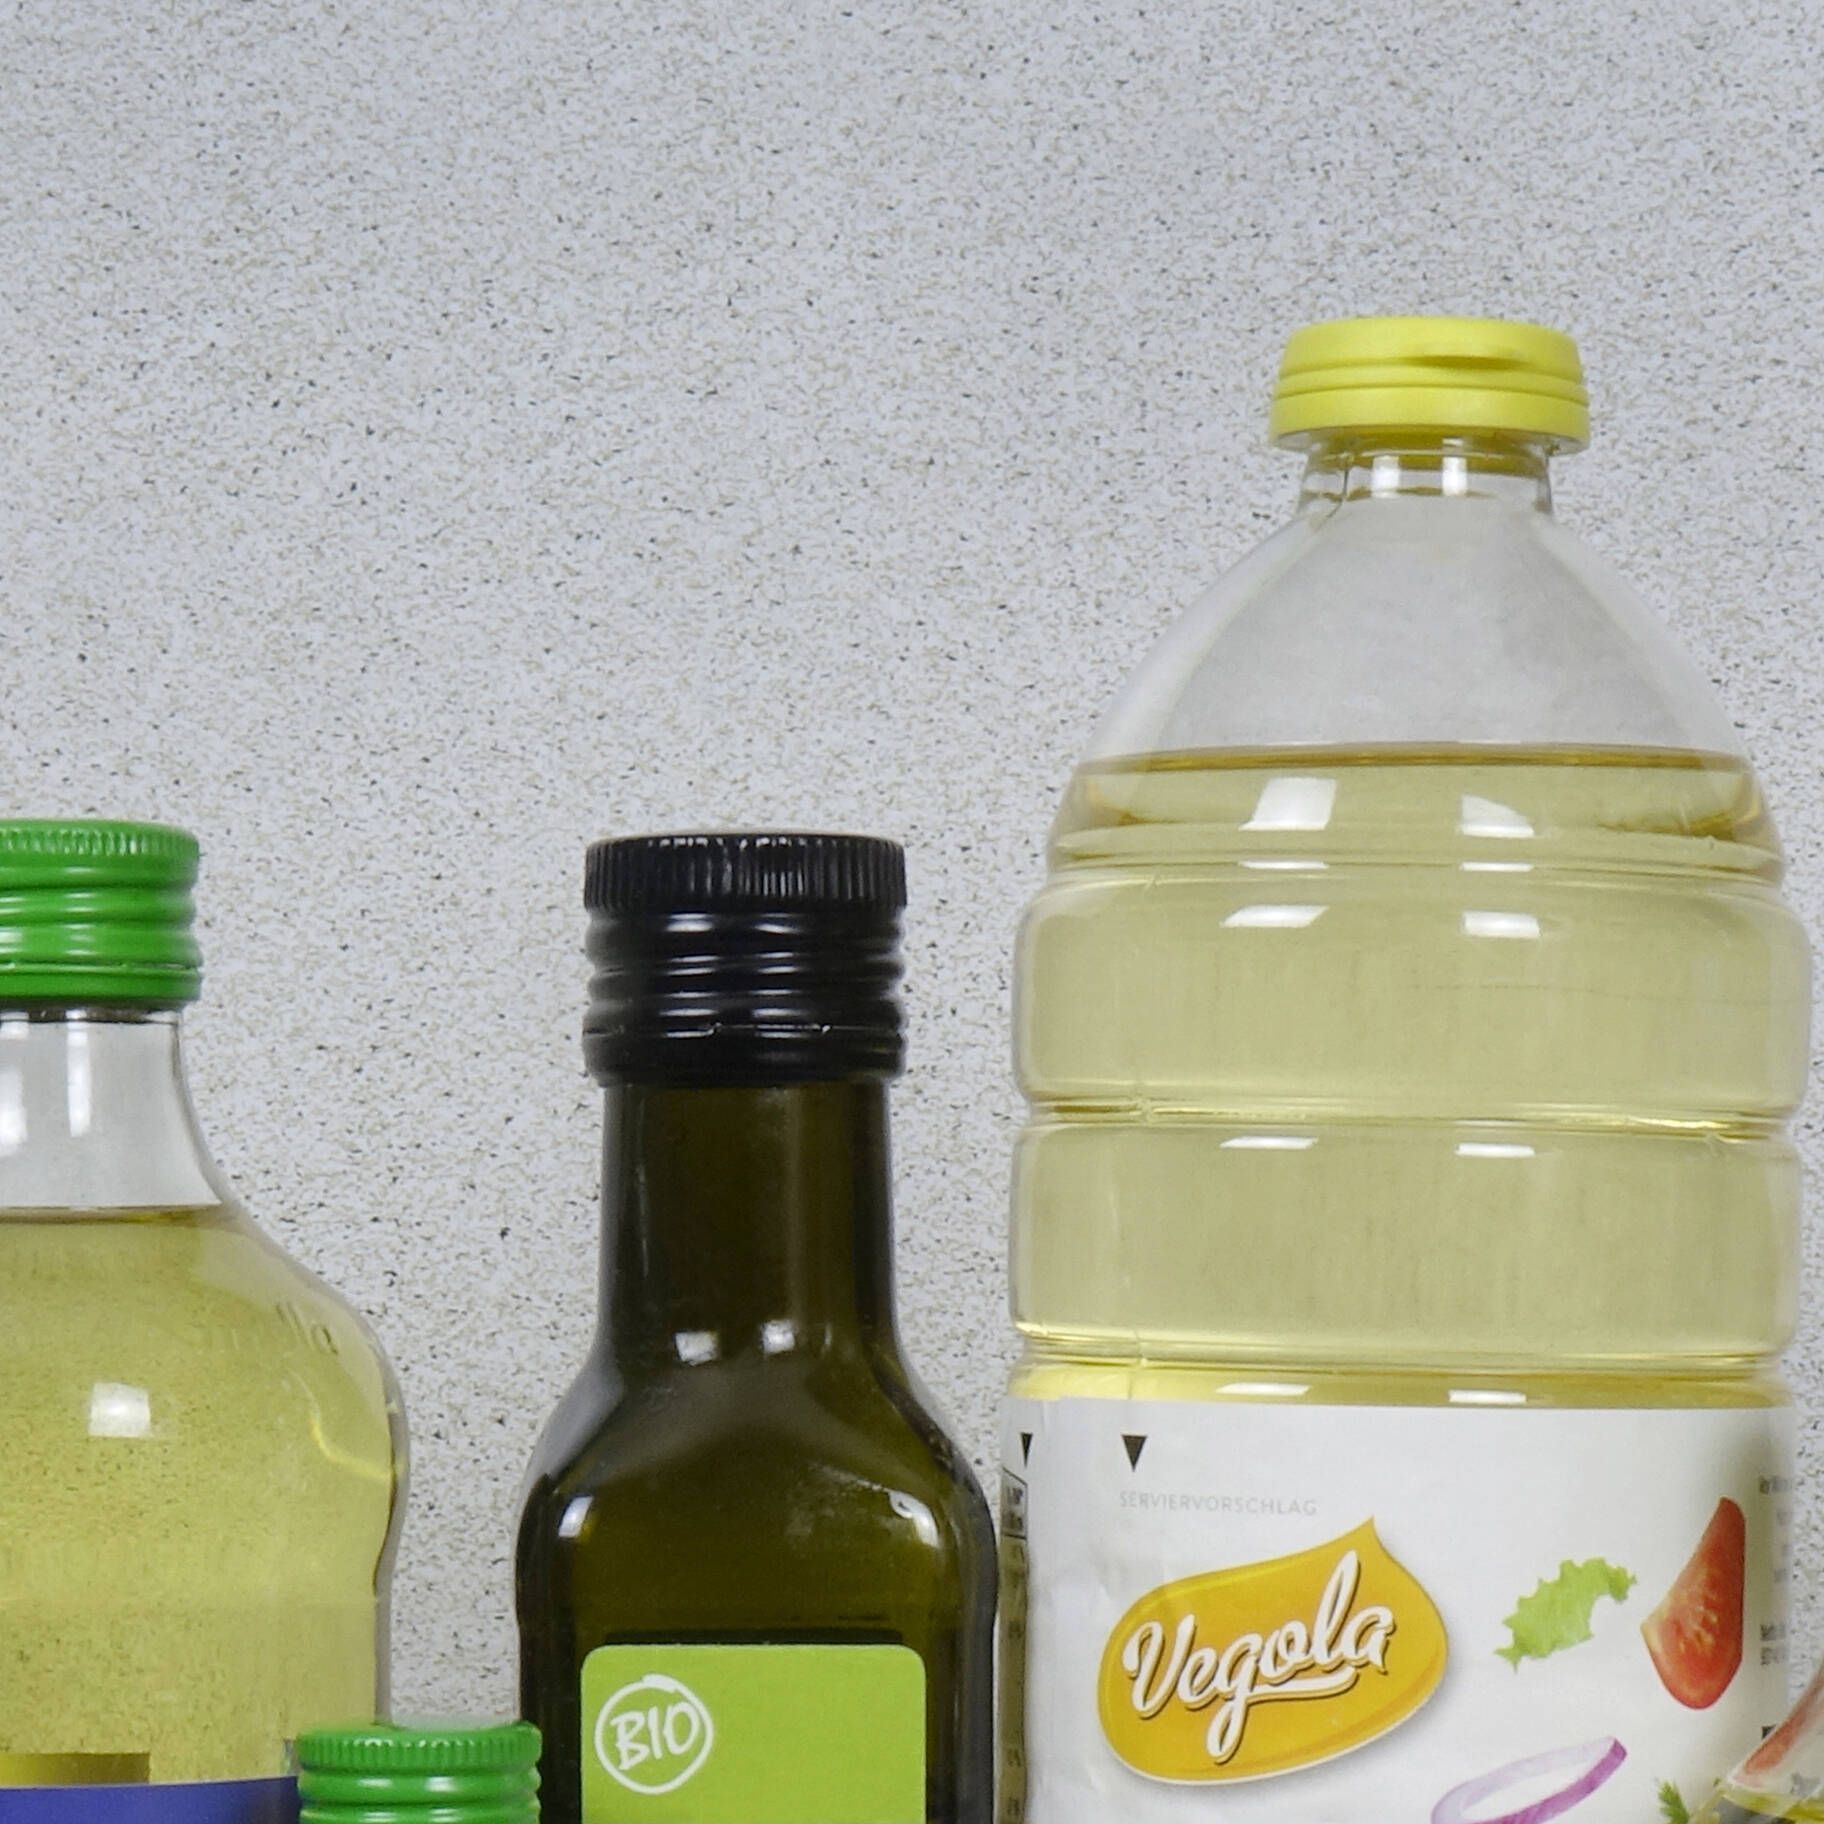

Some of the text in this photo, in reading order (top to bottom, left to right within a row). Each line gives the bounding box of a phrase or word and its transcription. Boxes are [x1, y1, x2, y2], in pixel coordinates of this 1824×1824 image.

[1120, 1490, 1317, 1516] SERVIERVORSCHLAG
[1121, 1549, 1396, 1764] Vegola
[610, 1701, 700, 1772] BIO
